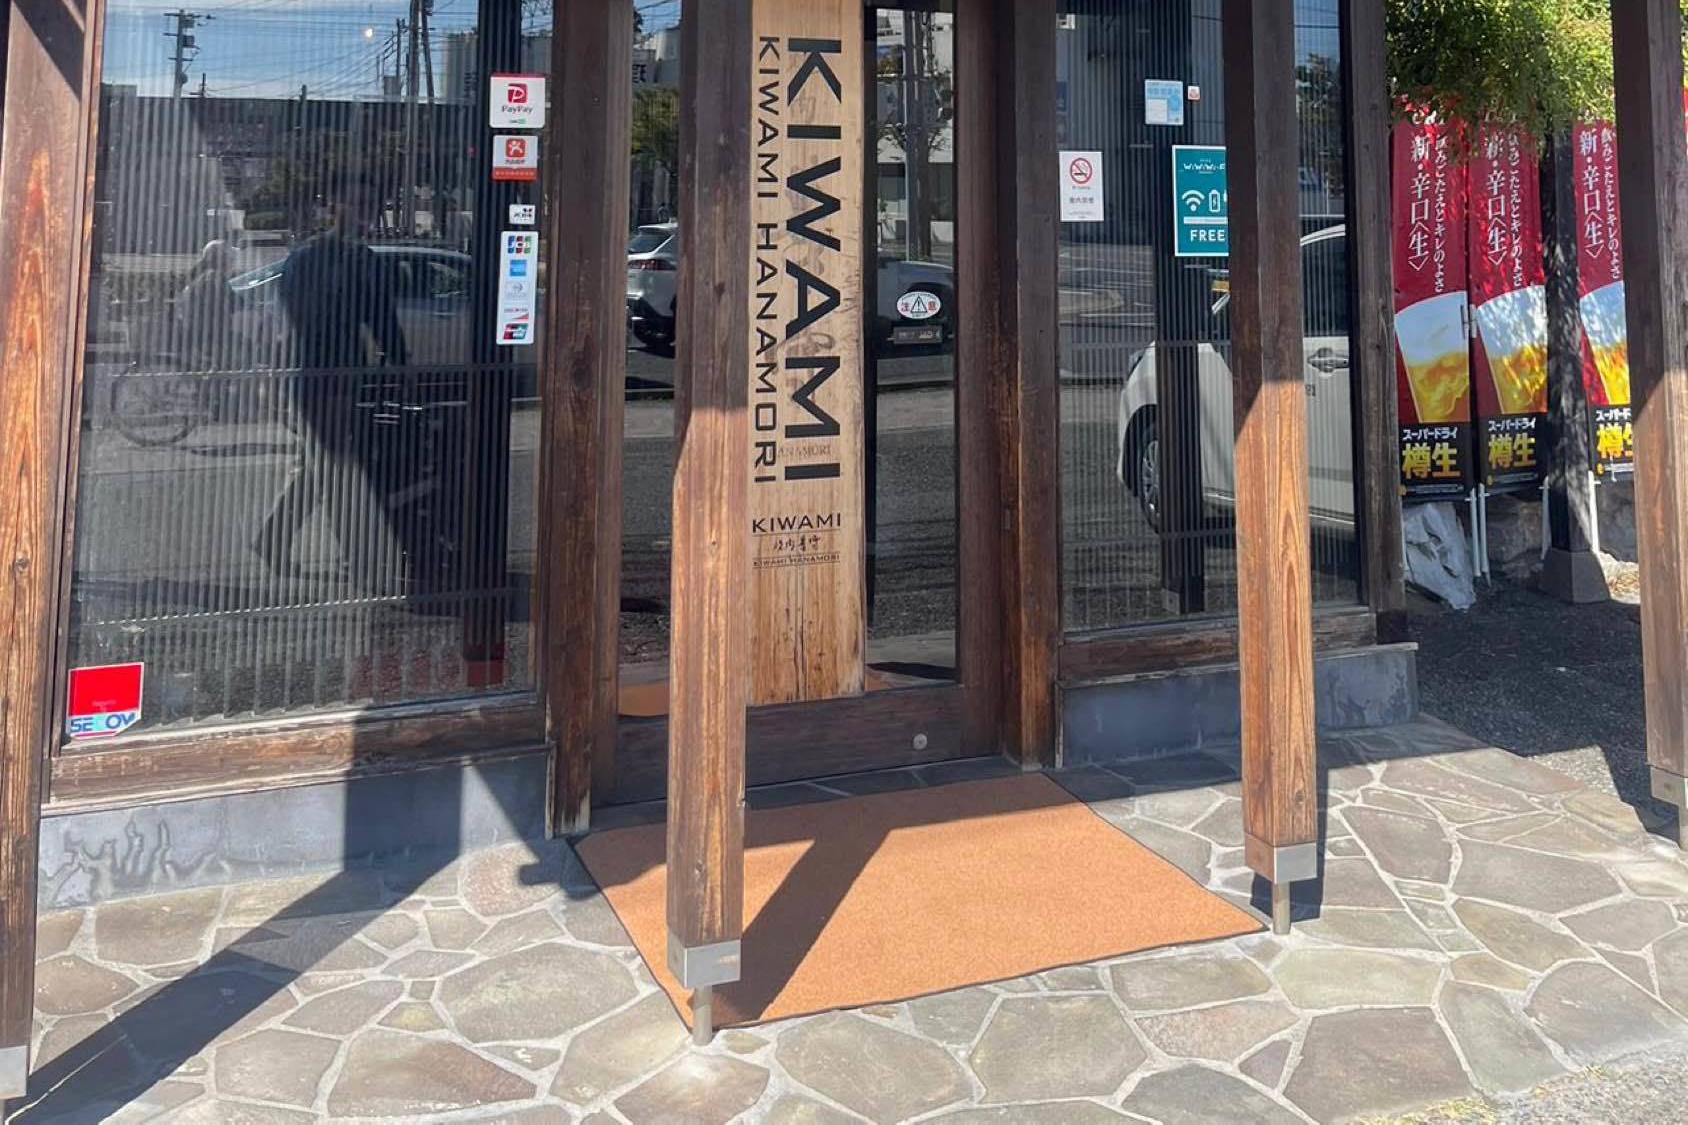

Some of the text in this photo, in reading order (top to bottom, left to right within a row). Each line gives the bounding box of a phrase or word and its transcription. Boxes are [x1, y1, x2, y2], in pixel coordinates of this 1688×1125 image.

[502, 105, 533, 114] PayPay
[1190, 229, 1225, 242] FREE
[755, 37, 780, 482] KIWAMI HANAMORI
[784, 38, 841, 480] KIWAMI
[1403, 426, 1458, 441] スーパードライ
[1489, 417, 1536, 430] スーパードライ
[1402, 441, 1461, 480] 樽生
[1488, 432, 1537, 470] 樽生
[752, 512, 841, 534] KIWAMI
